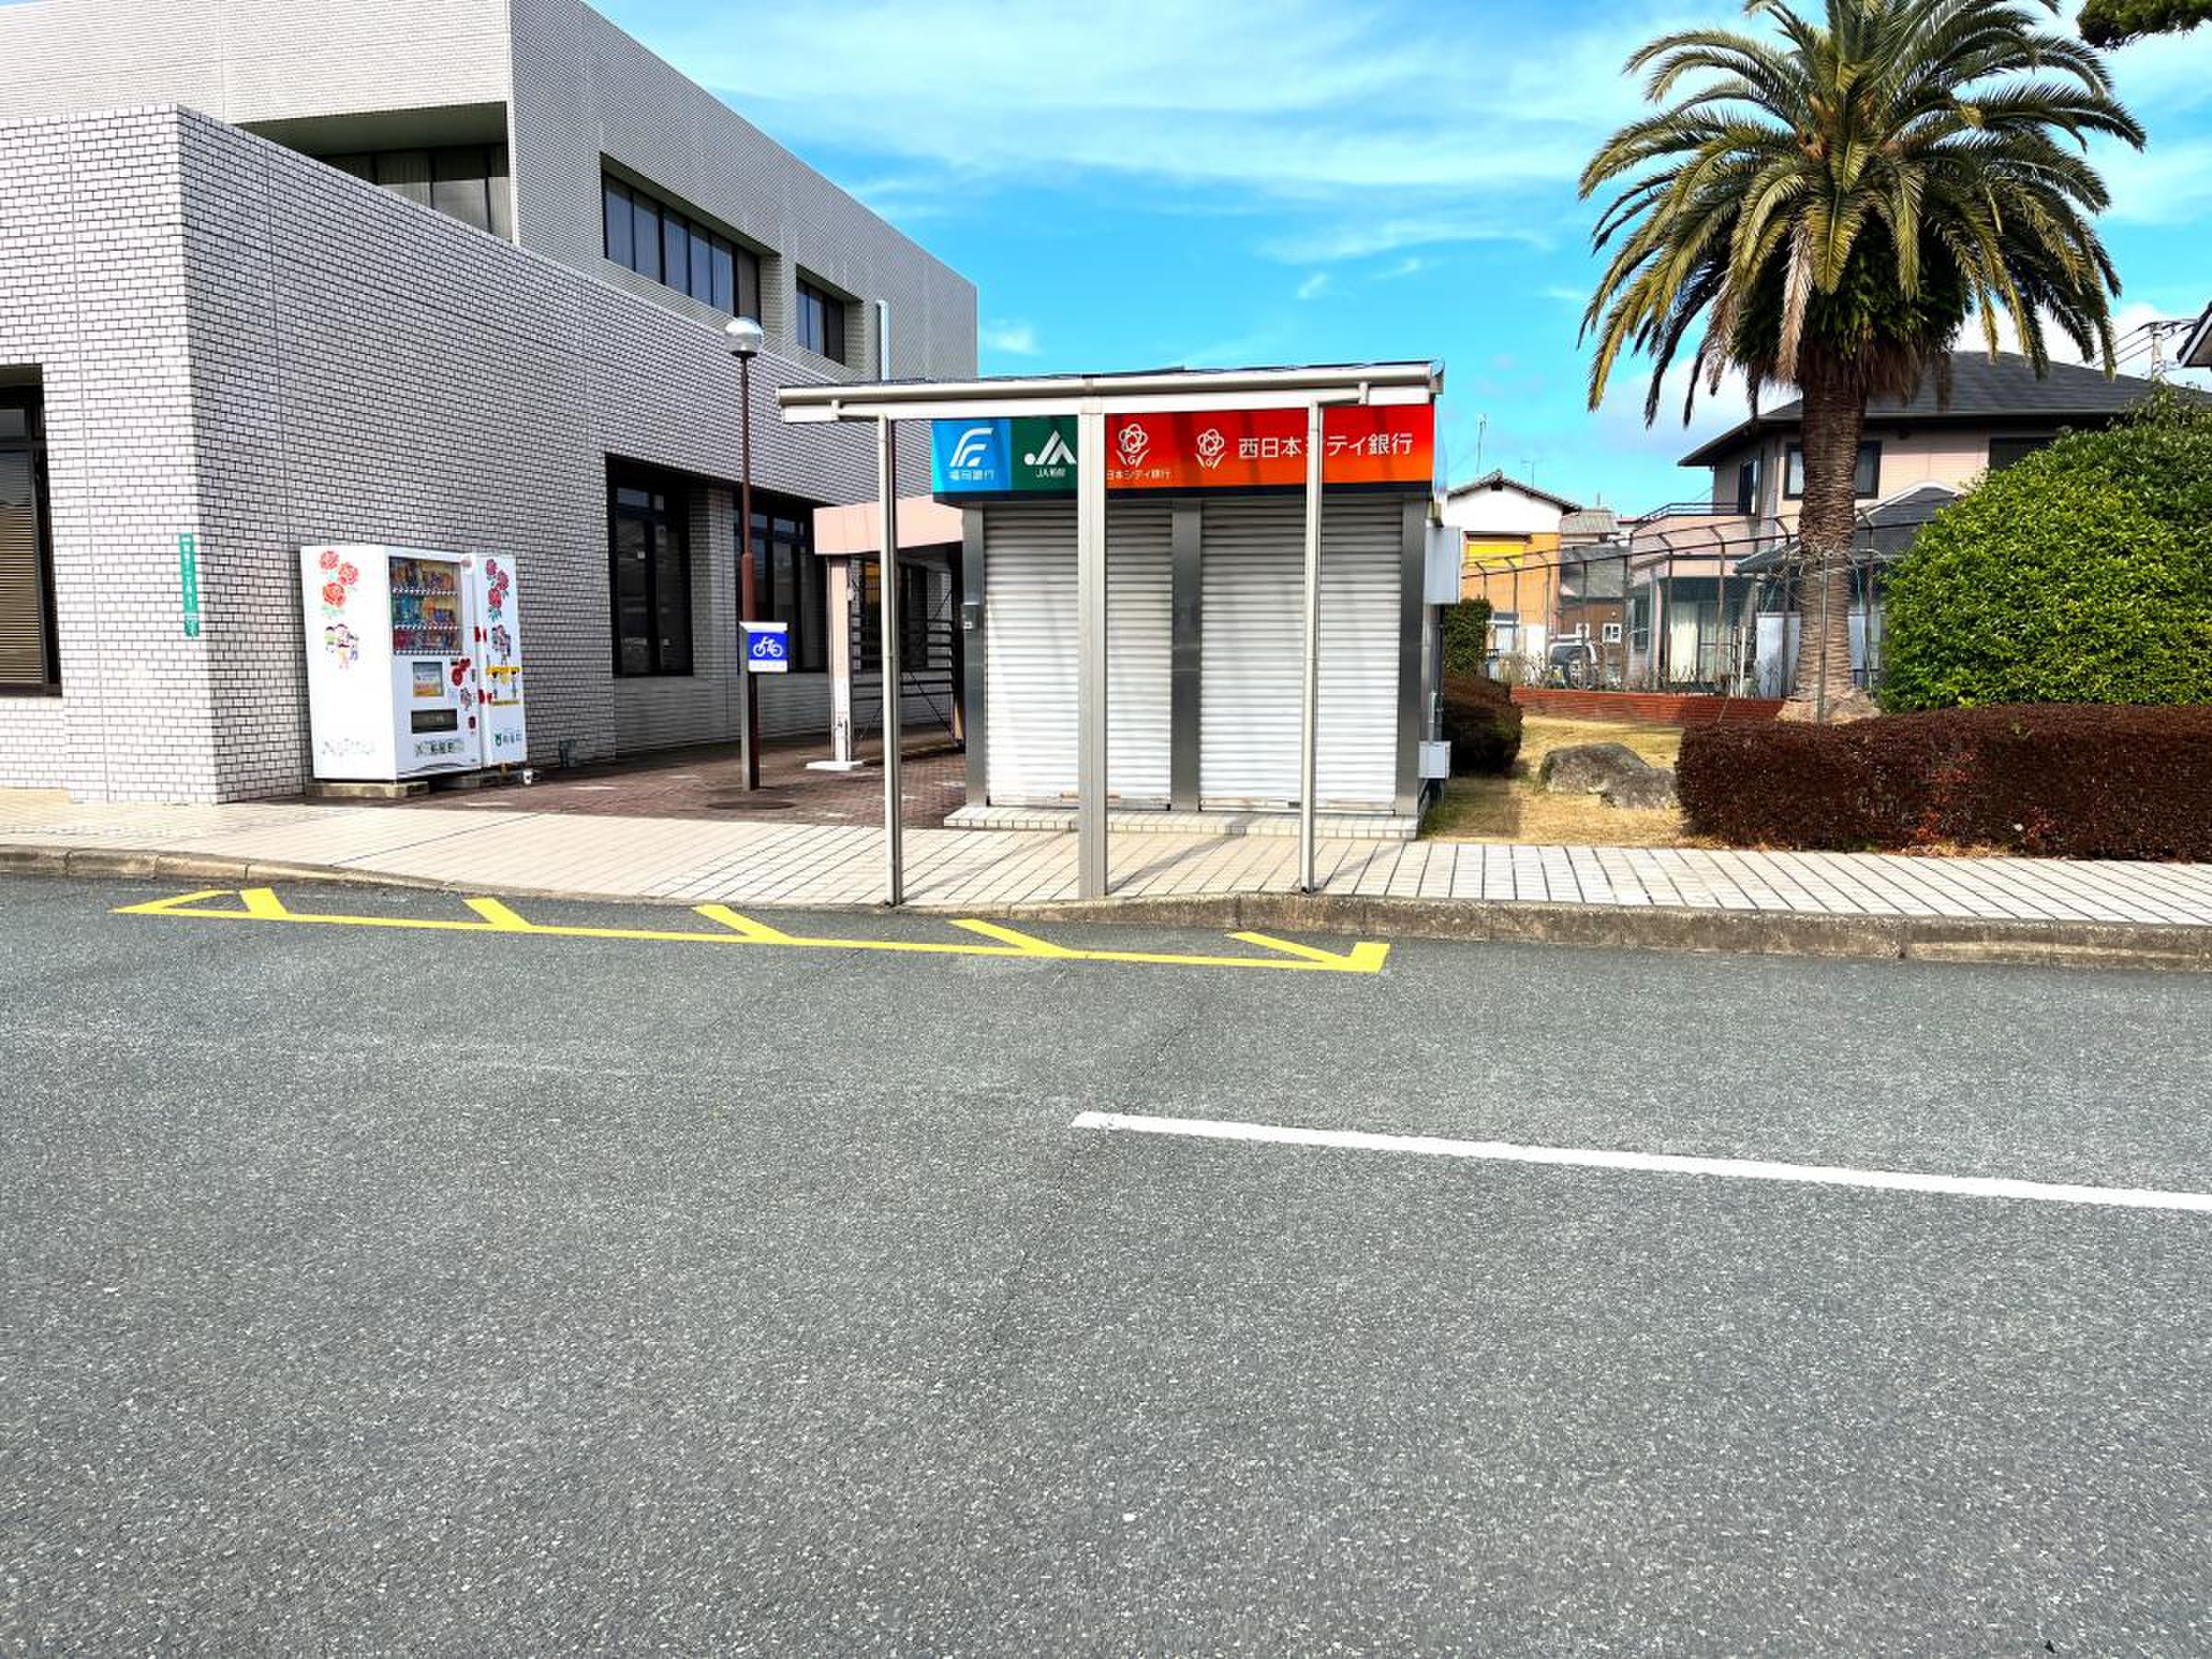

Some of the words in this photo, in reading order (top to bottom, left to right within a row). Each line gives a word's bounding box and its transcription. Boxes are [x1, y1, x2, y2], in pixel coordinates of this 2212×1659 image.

[1239, 433, 1413, 458] 西日本ティ銀行
[1106, 468, 1171, 480] 日本シティ銀行
